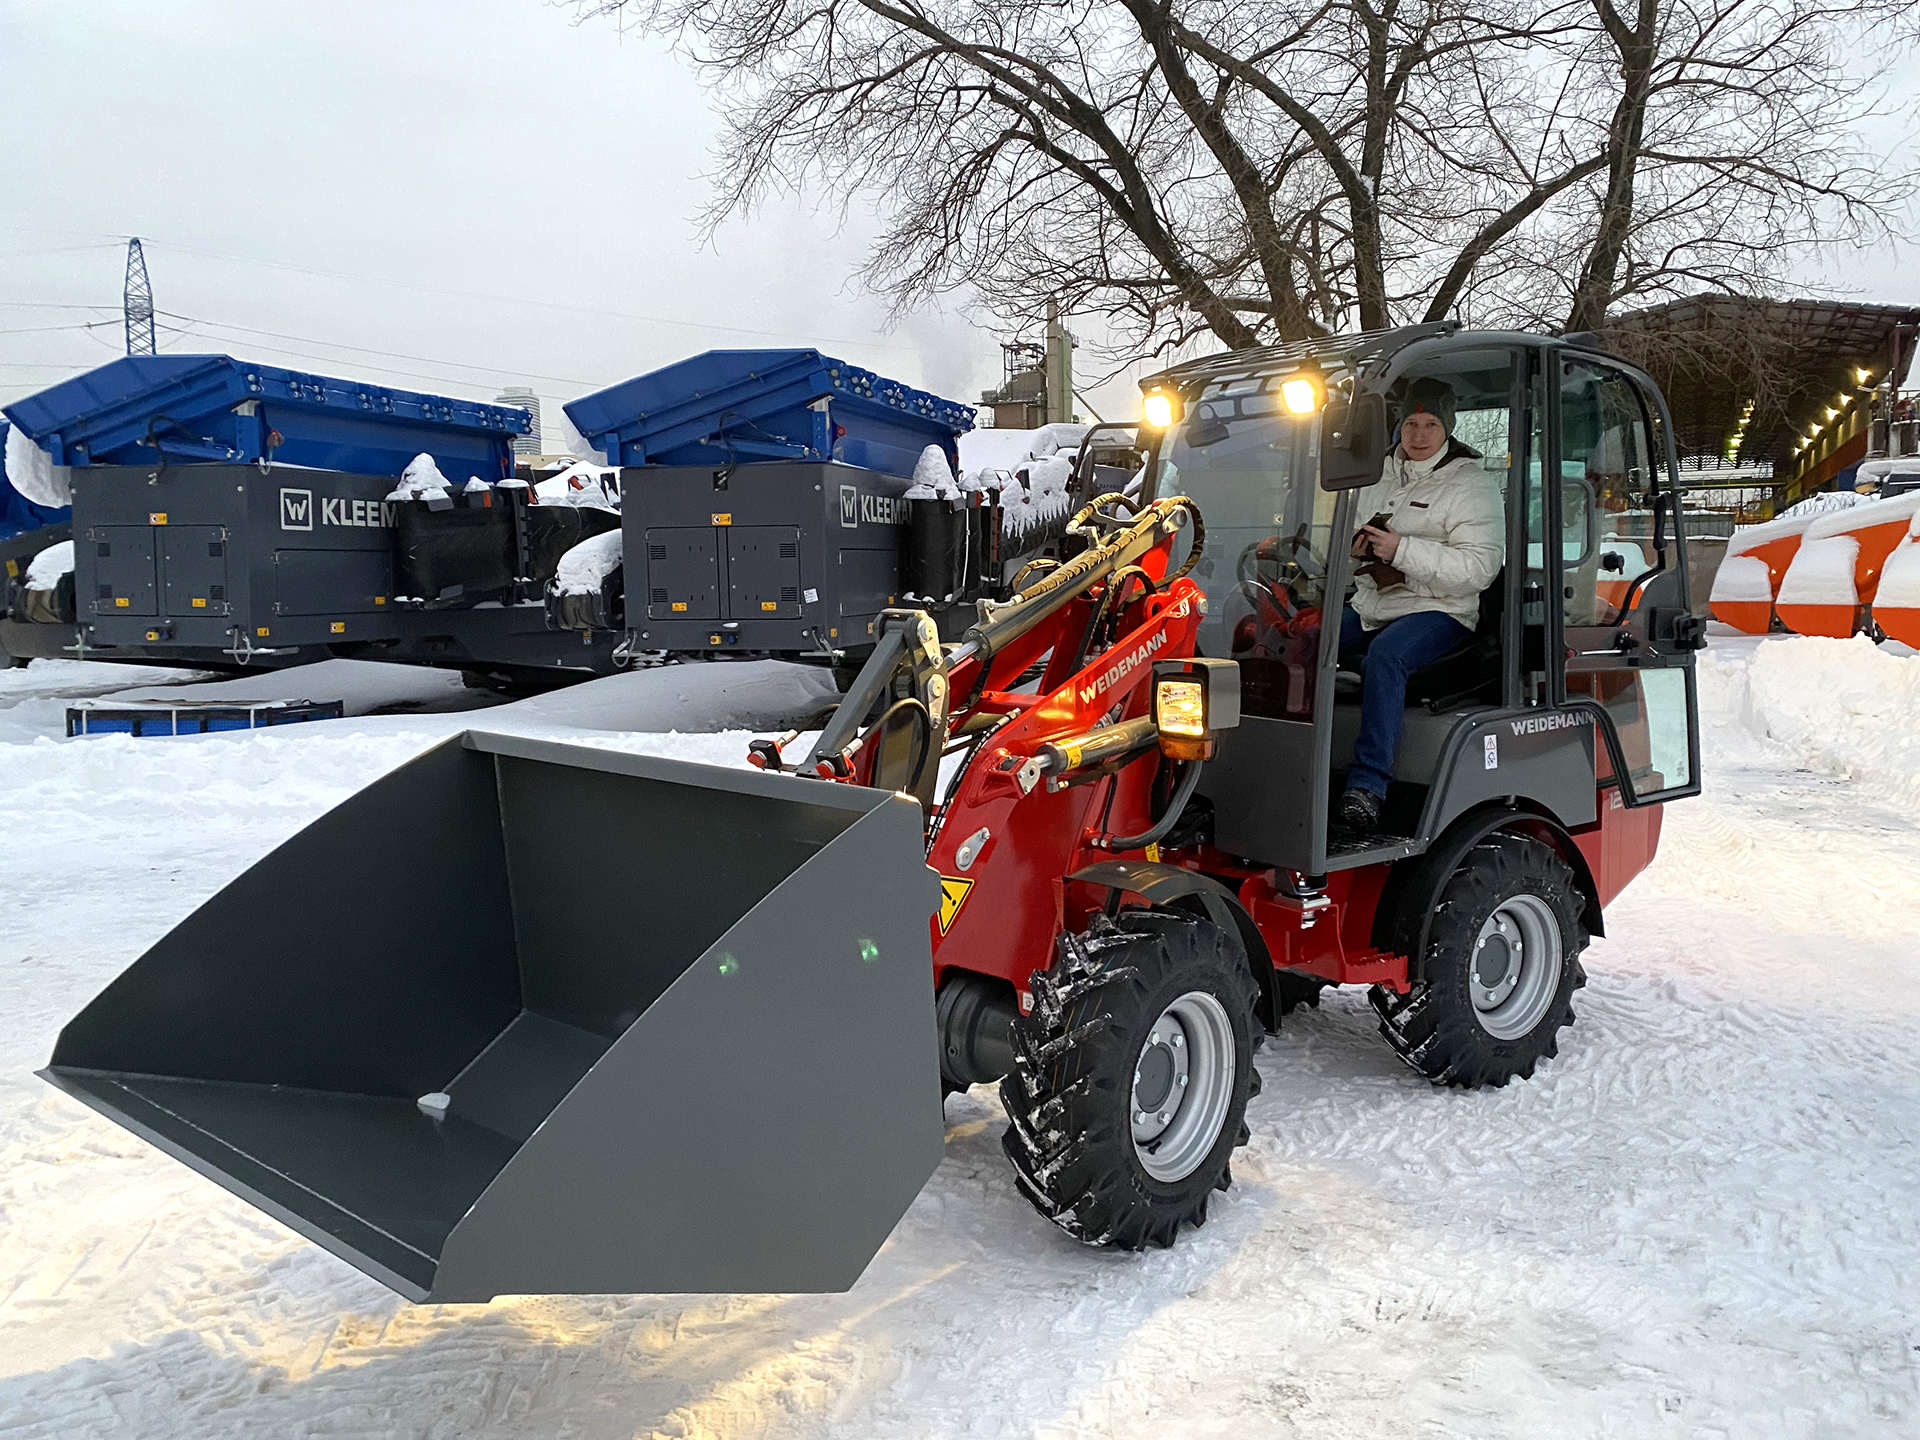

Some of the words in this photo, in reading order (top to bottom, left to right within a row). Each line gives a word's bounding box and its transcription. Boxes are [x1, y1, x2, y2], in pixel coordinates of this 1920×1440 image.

[321, 498, 399, 528] KLEEM
[1080, 628, 1168, 704] WEIDEMANN
[1511, 711, 1594, 736] WEIDEMANN
